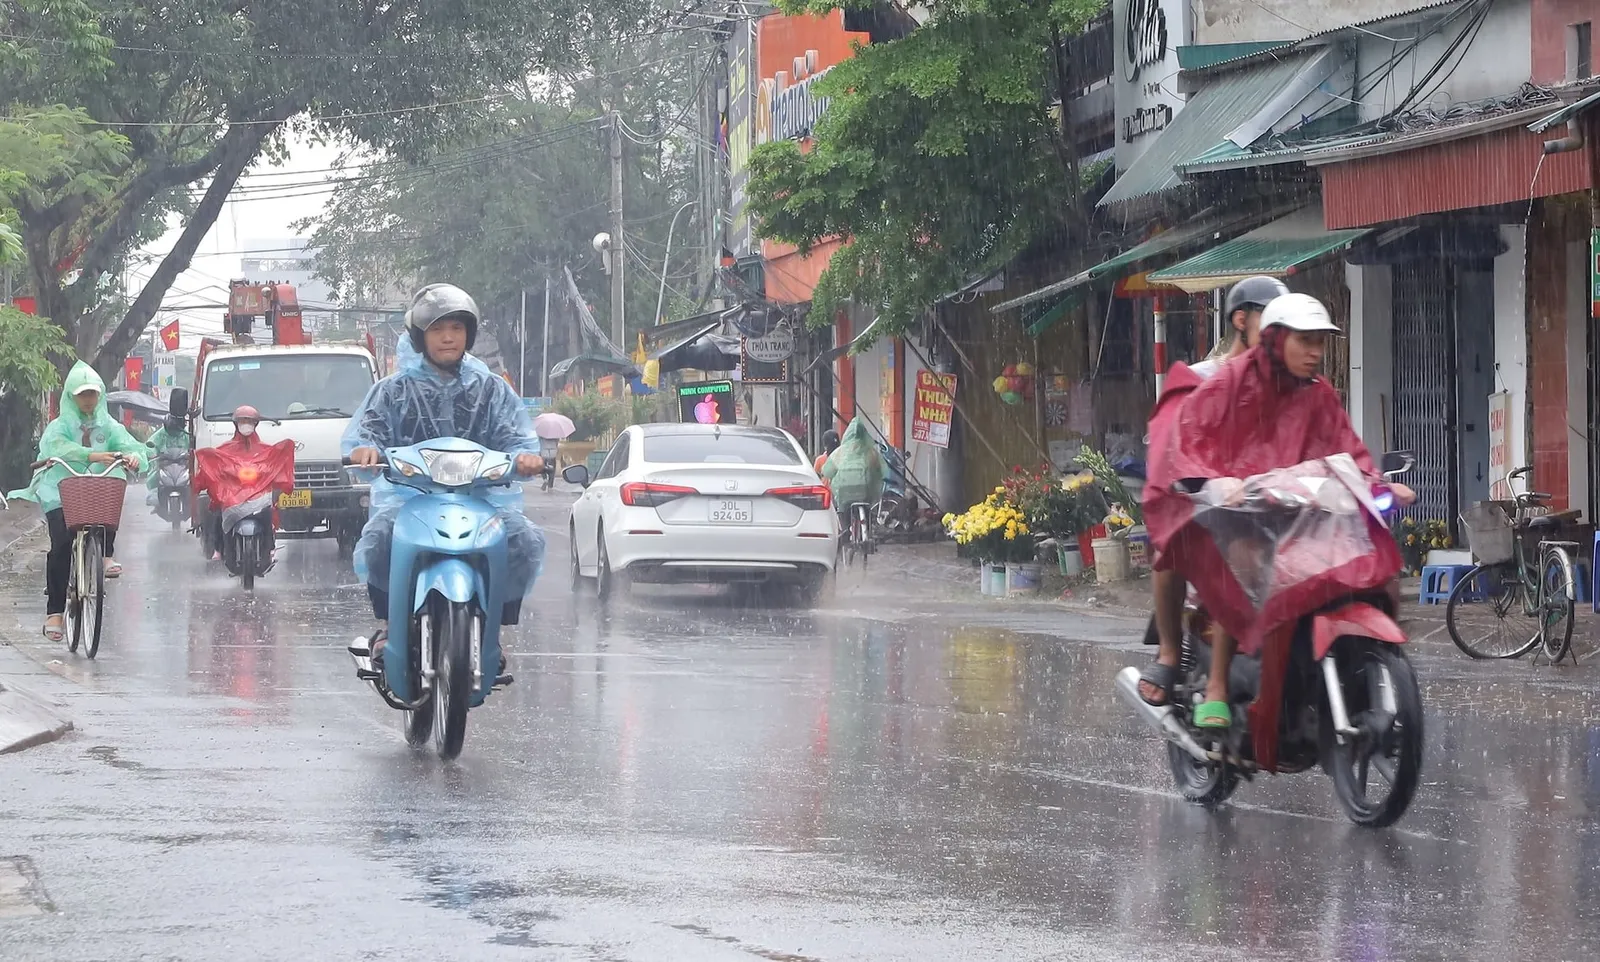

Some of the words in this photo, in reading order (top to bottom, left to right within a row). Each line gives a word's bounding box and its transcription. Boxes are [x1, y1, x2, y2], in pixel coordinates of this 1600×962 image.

[697, 384, 730, 394] COMPUTER
[721, 501, 740, 511] 30L
[713, 510, 748, 521] 924.05
